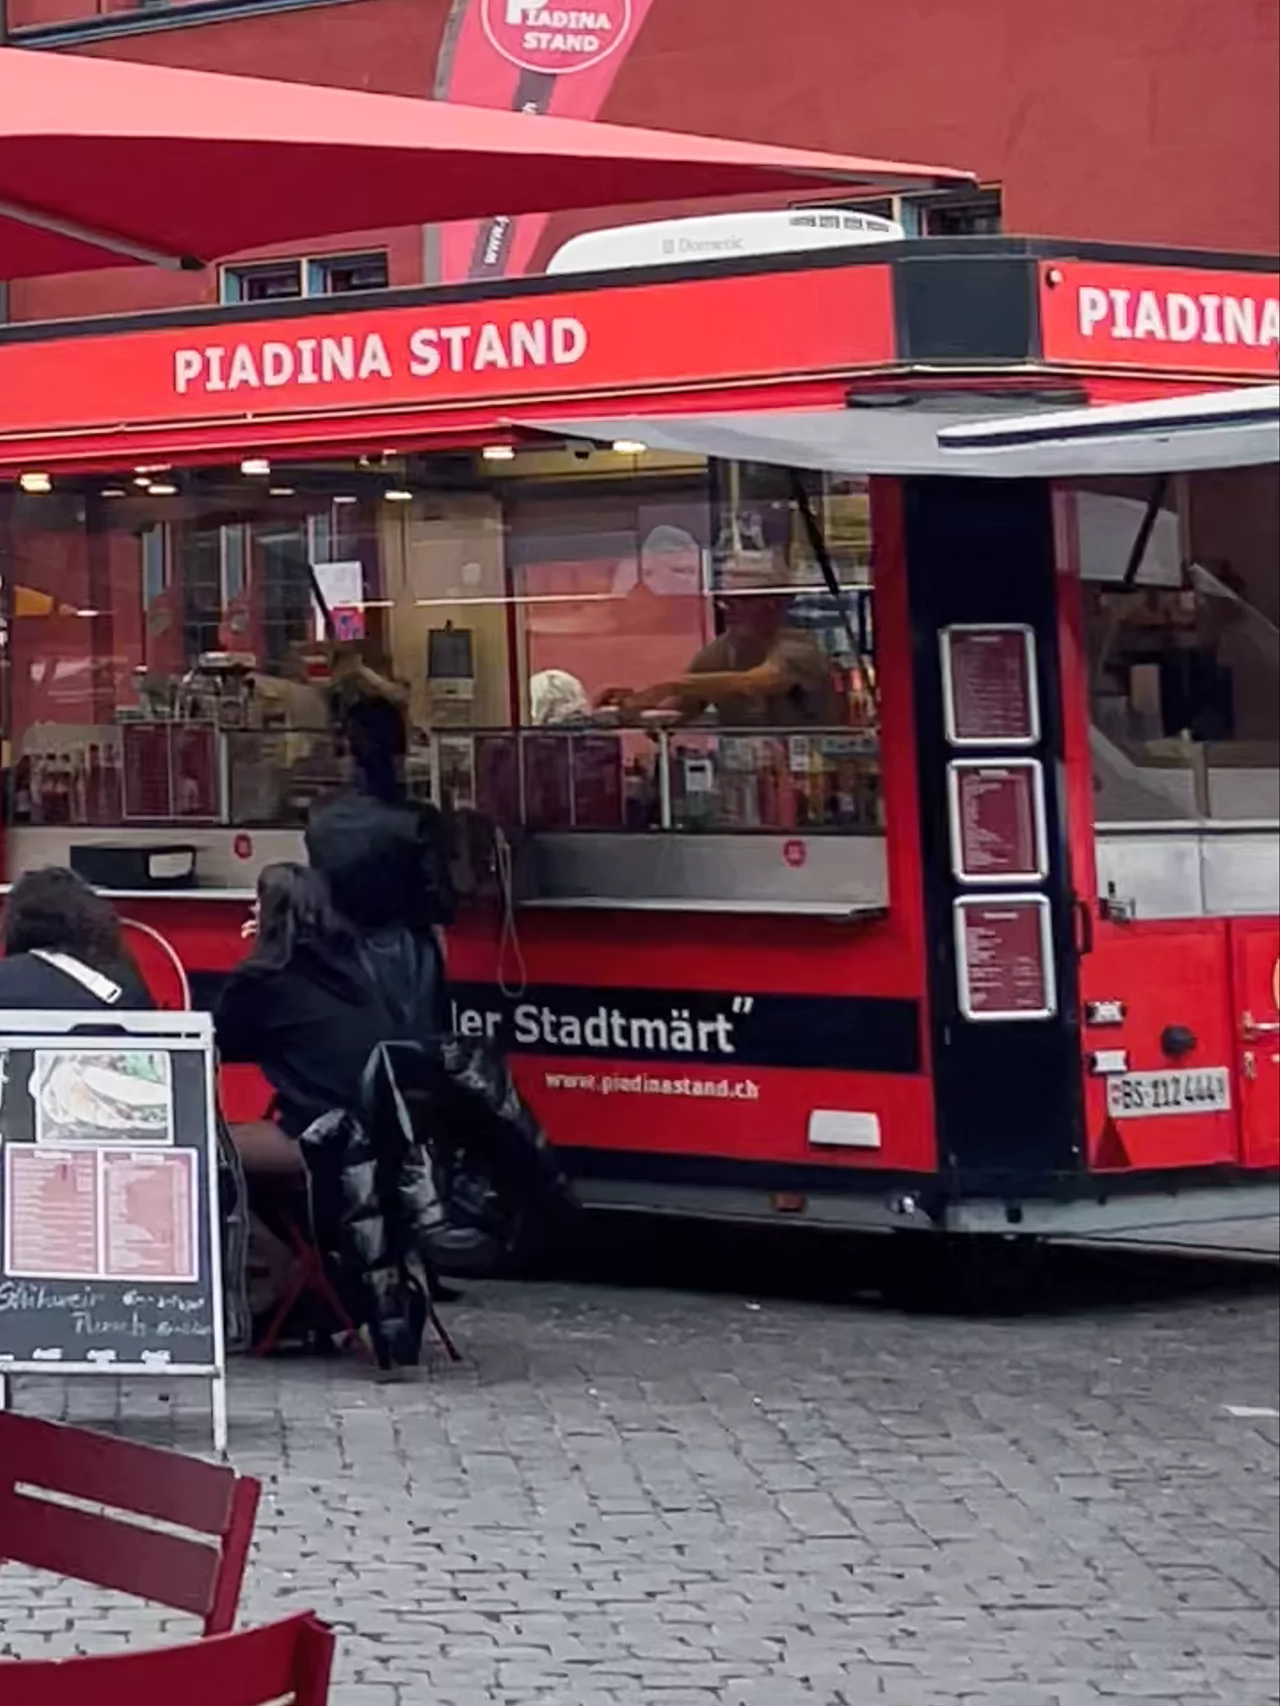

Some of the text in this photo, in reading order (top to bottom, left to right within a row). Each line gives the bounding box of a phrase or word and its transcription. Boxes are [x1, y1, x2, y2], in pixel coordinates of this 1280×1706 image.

[522, 31, 601, 53] STAND
[174, 316, 589, 394] PIADINA STAND
